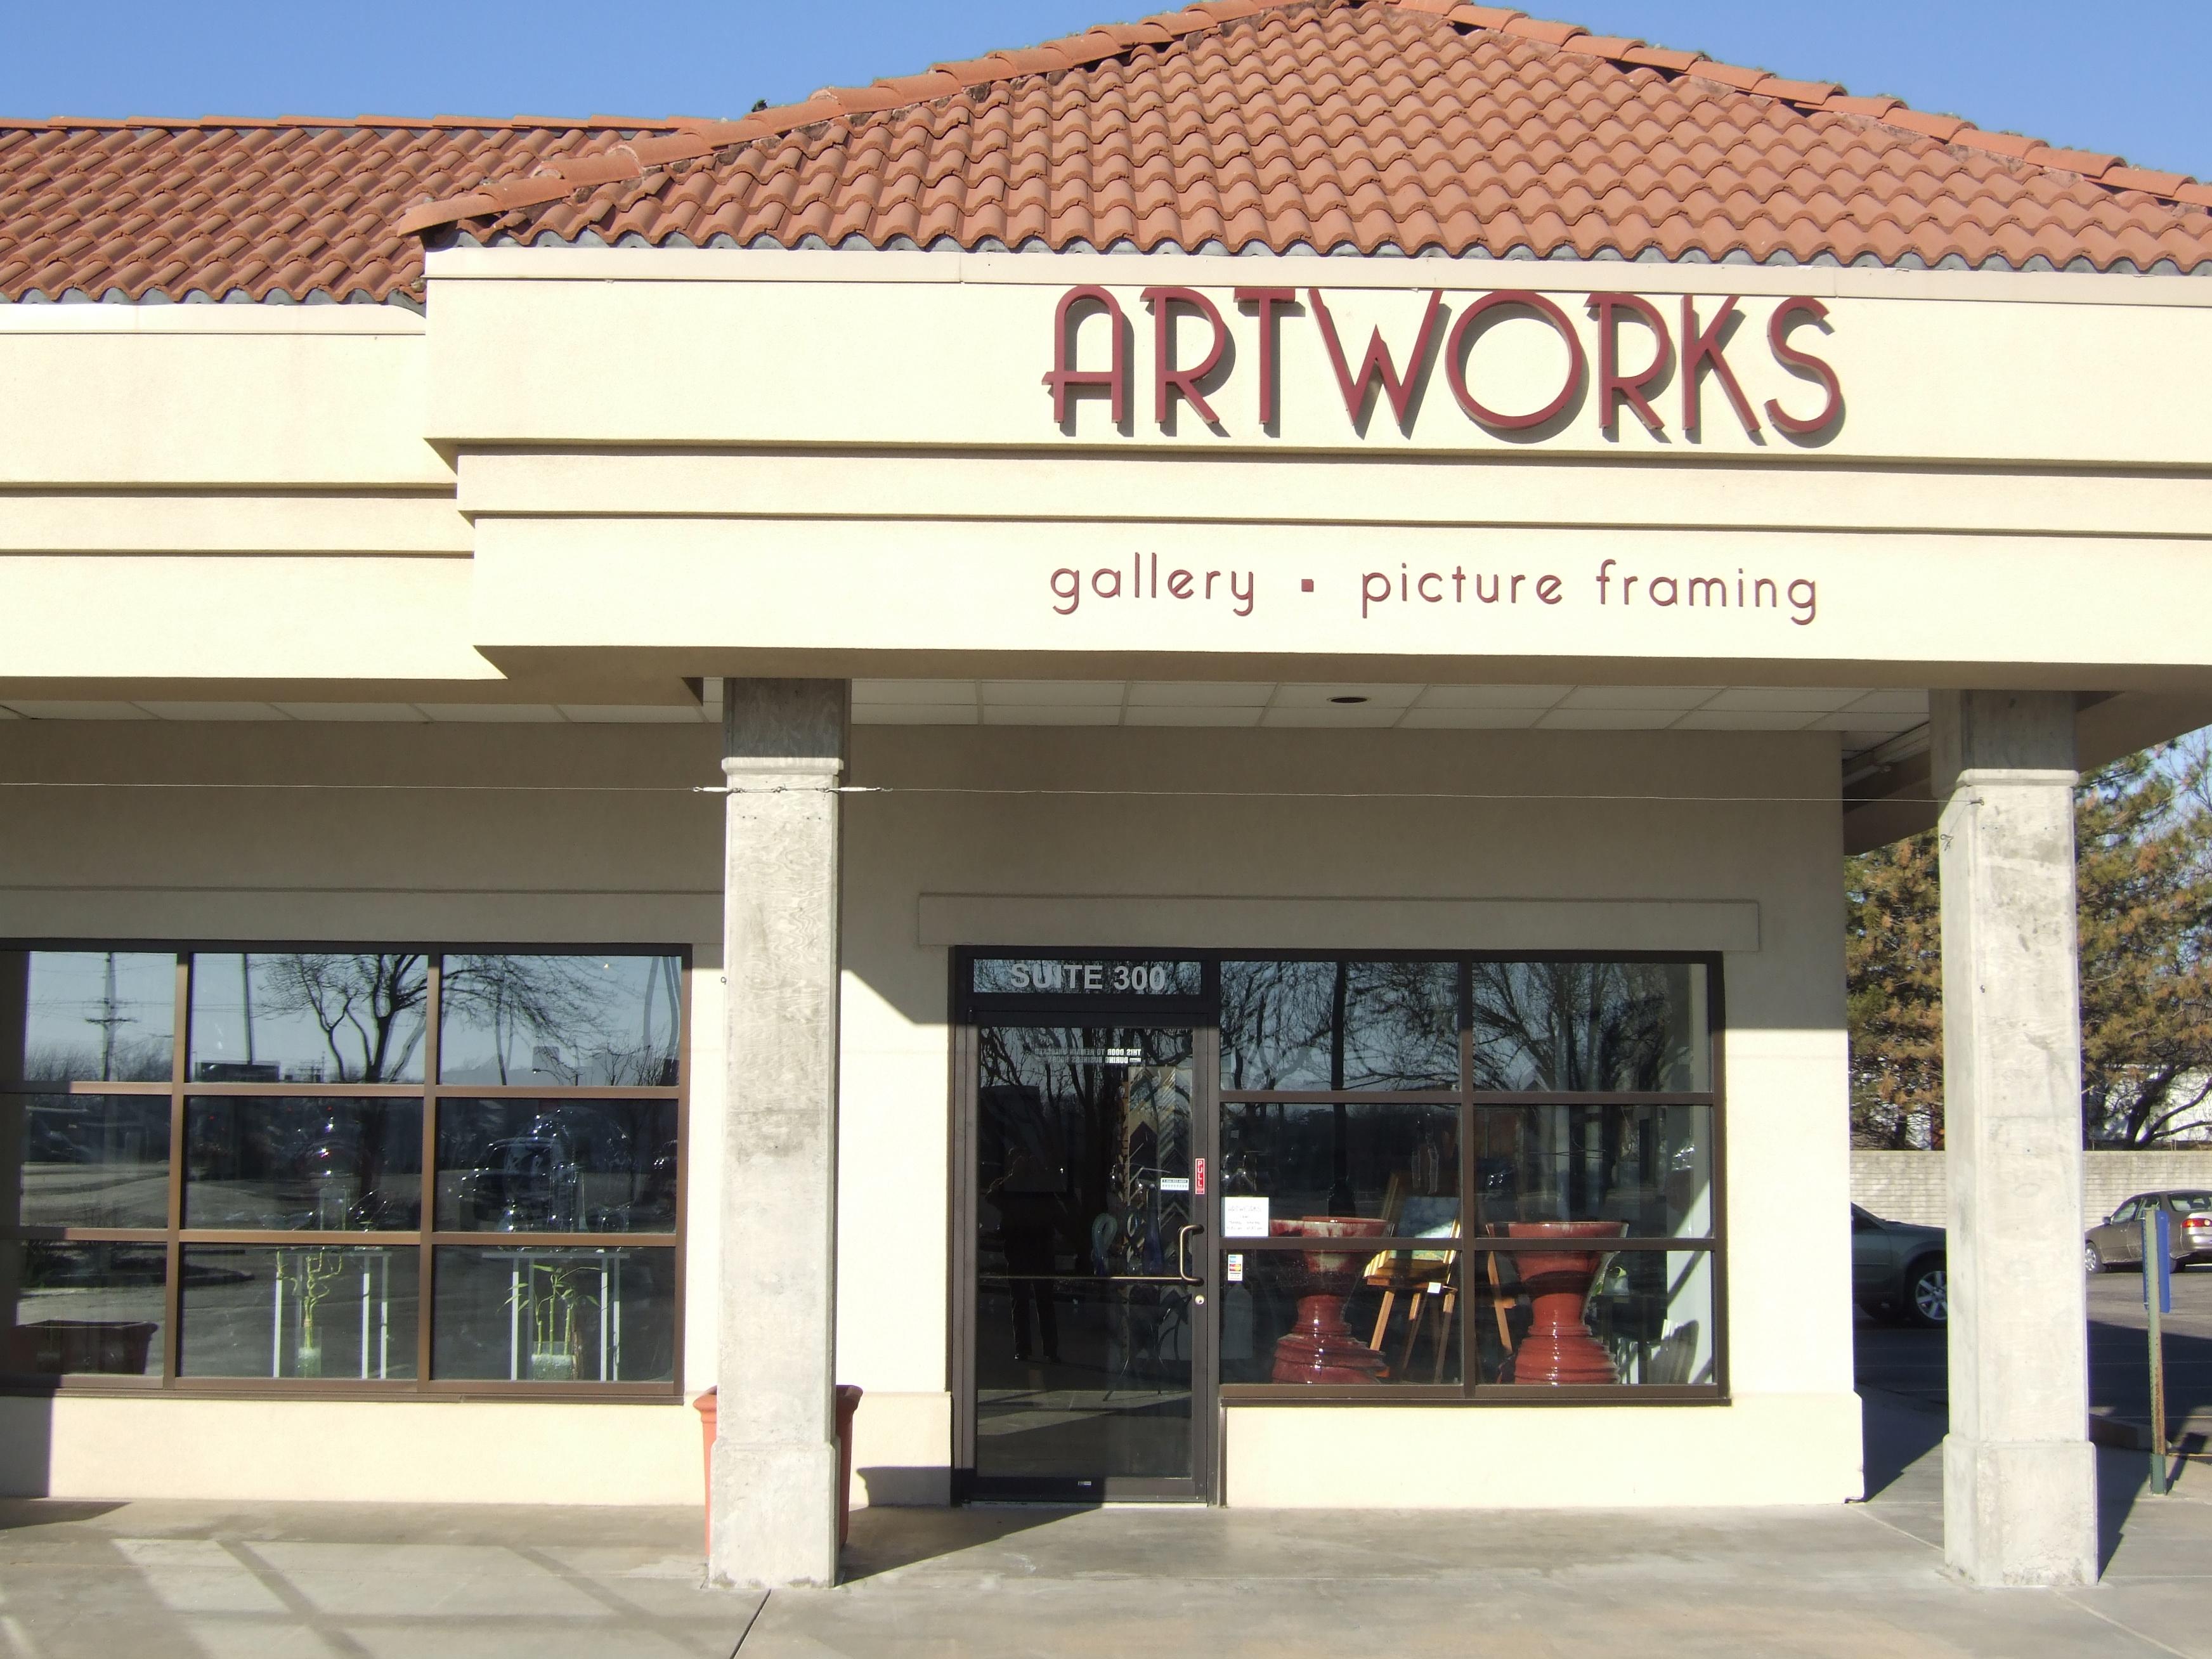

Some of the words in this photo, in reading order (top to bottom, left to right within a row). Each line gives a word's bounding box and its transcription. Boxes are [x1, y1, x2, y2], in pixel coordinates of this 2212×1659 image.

[1041, 285, 1842, 433] ARTWORKS
[1050, 552, 1254, 617] gallery
[1361, 561, 1563, 619] picture
[1596, 559, 1818, 625] framing
[1010, 963, 1103, 989] SUITE
[1114, 965, 1166, 991] 300
